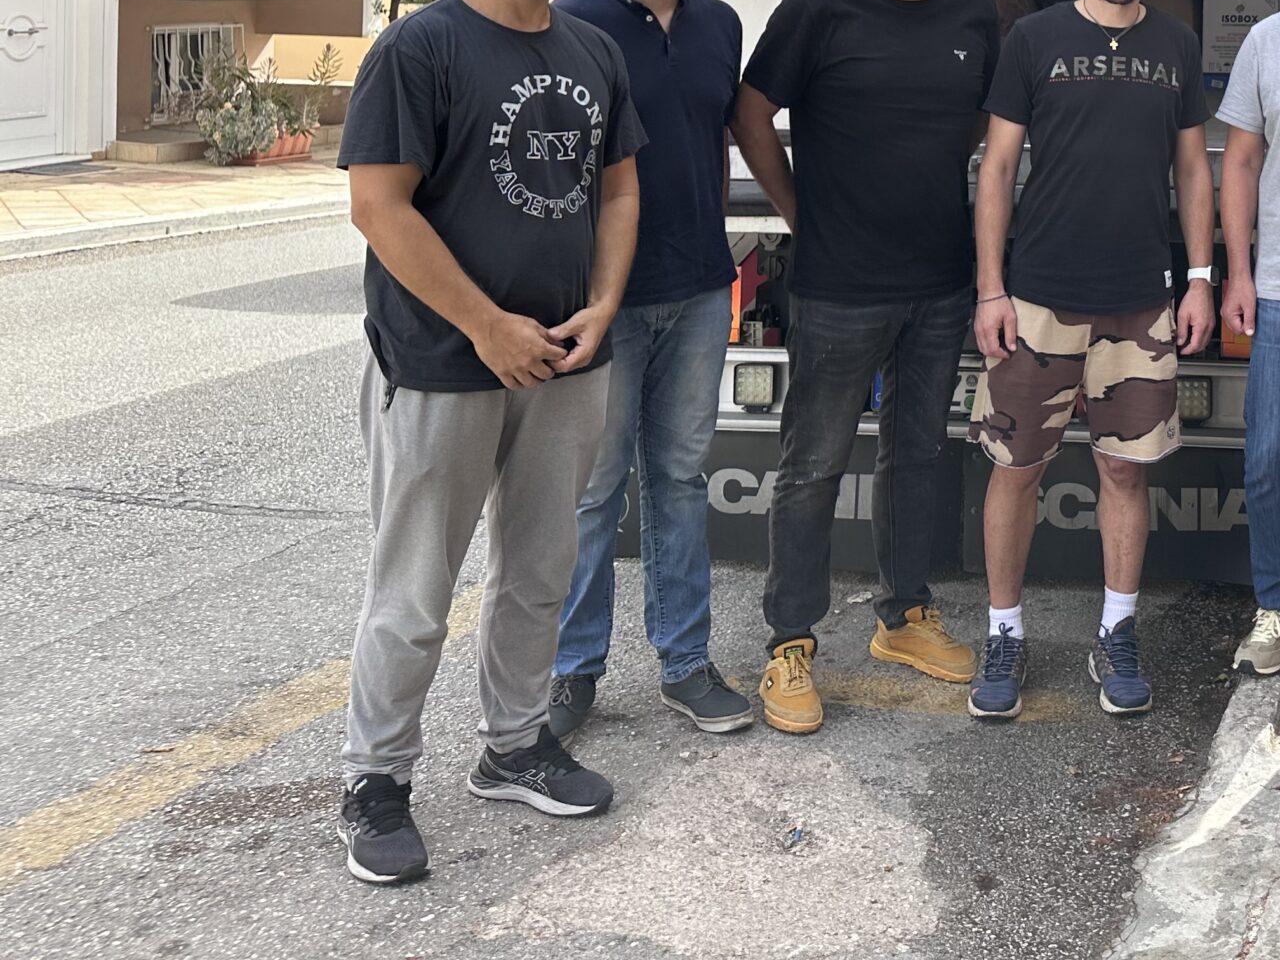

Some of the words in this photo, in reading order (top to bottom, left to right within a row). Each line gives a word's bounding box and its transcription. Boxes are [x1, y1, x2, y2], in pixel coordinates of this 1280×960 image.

[1221, 14, 1259, 24] ISOBOX
[1049, 55, 1180, 88] ARSENAL
[489, 74, 603, 147] HAMPTONS
[526, 130, 581, 161] NY
[489, 150, 565, 219] YACHT
